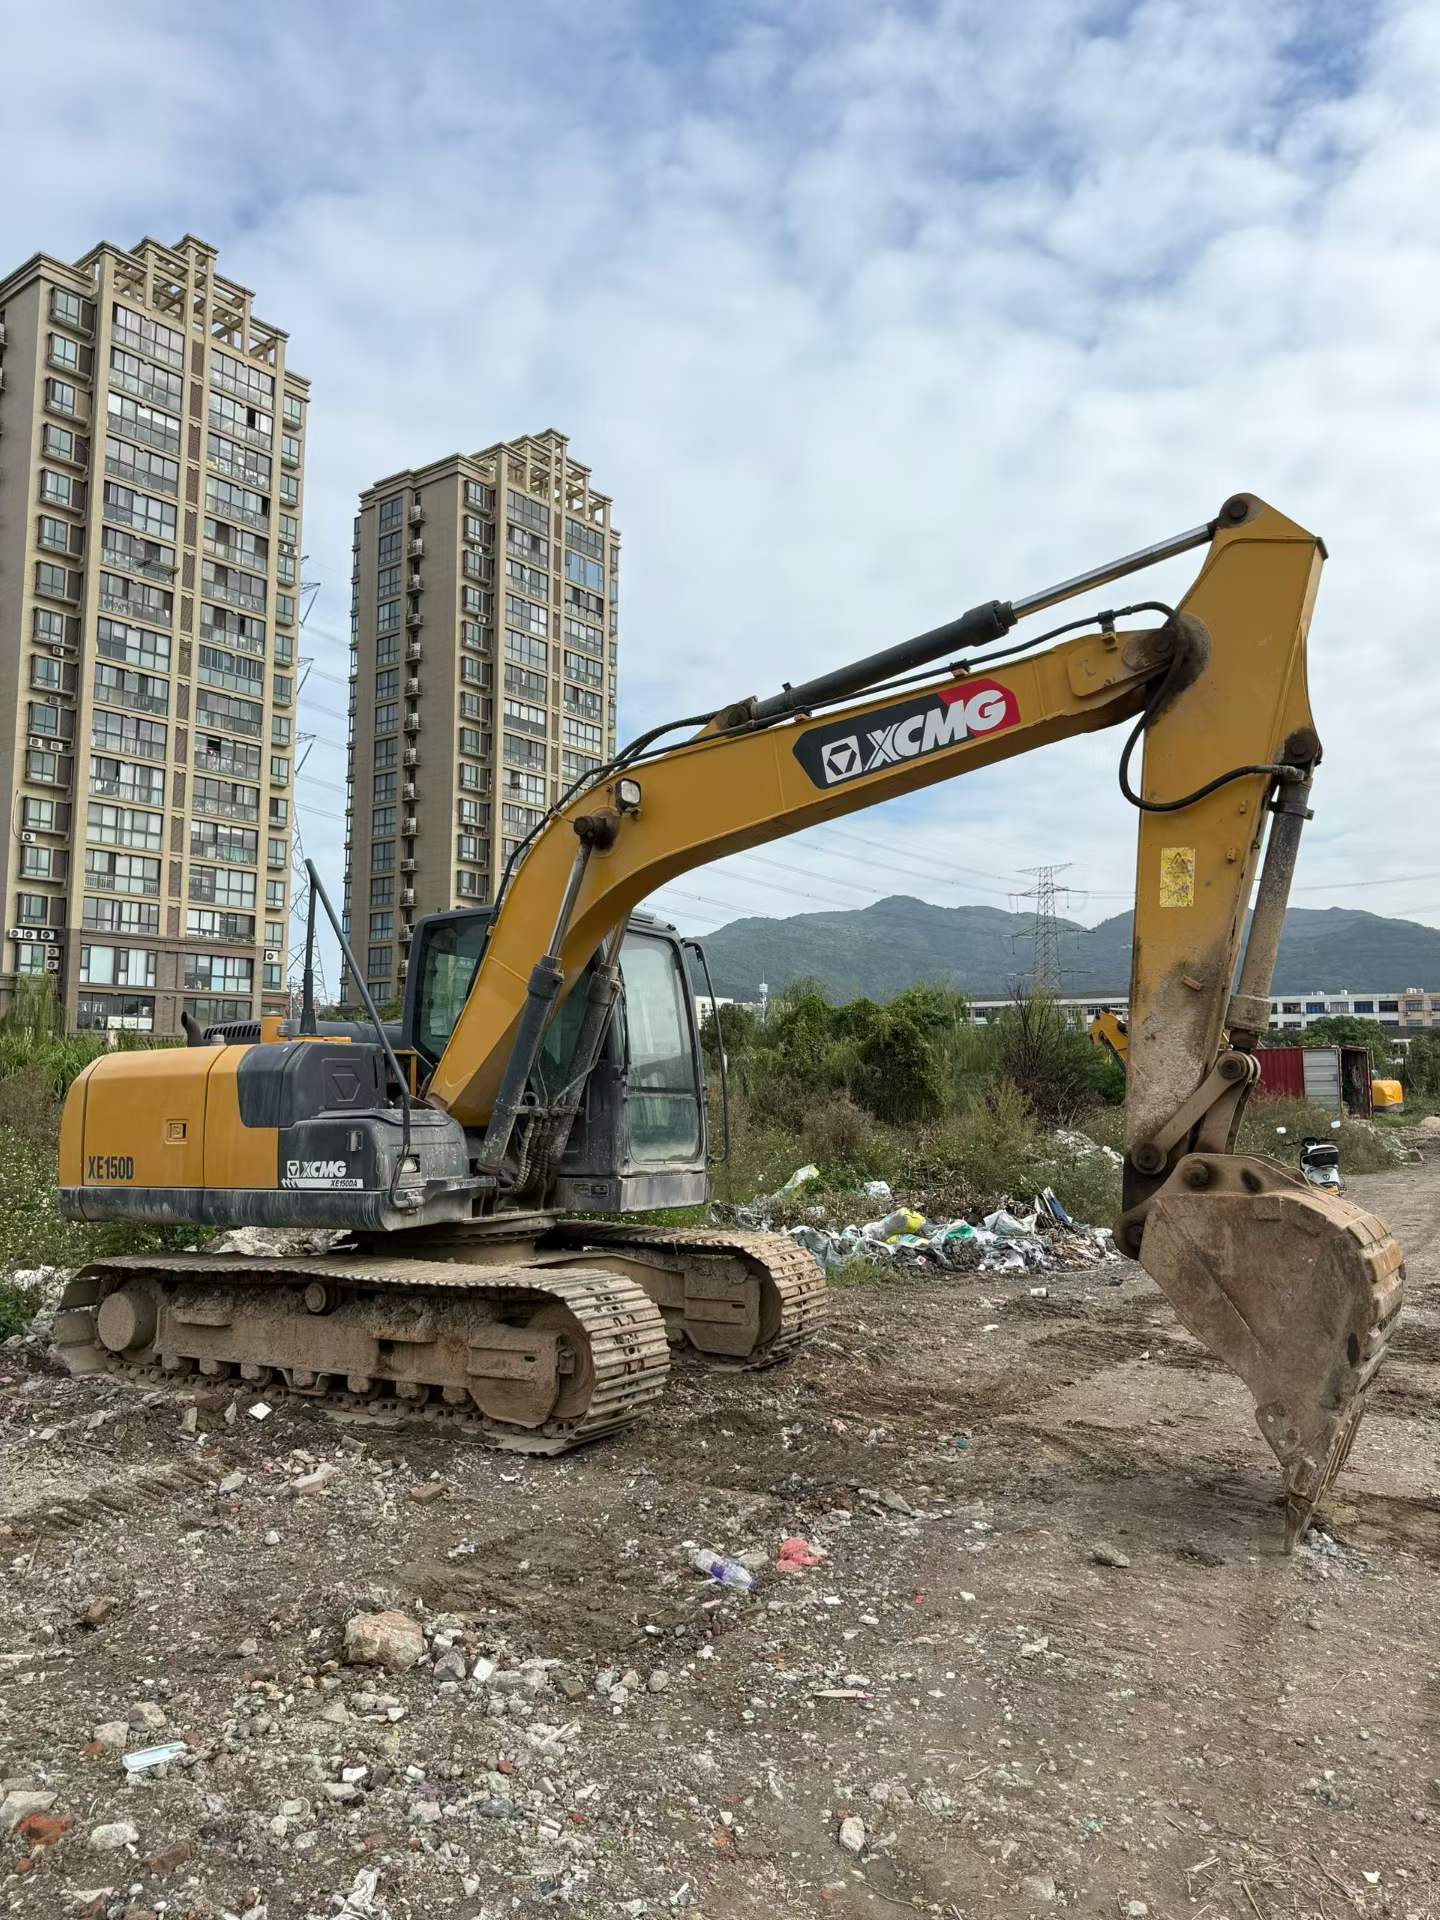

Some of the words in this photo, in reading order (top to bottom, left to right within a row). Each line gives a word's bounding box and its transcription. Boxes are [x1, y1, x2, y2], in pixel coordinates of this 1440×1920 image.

[863, 689, 1006, 771] XCMG
[88, 1155, 134, 1180] XE150D
[300, 1160, 347, 1178] XCMG
